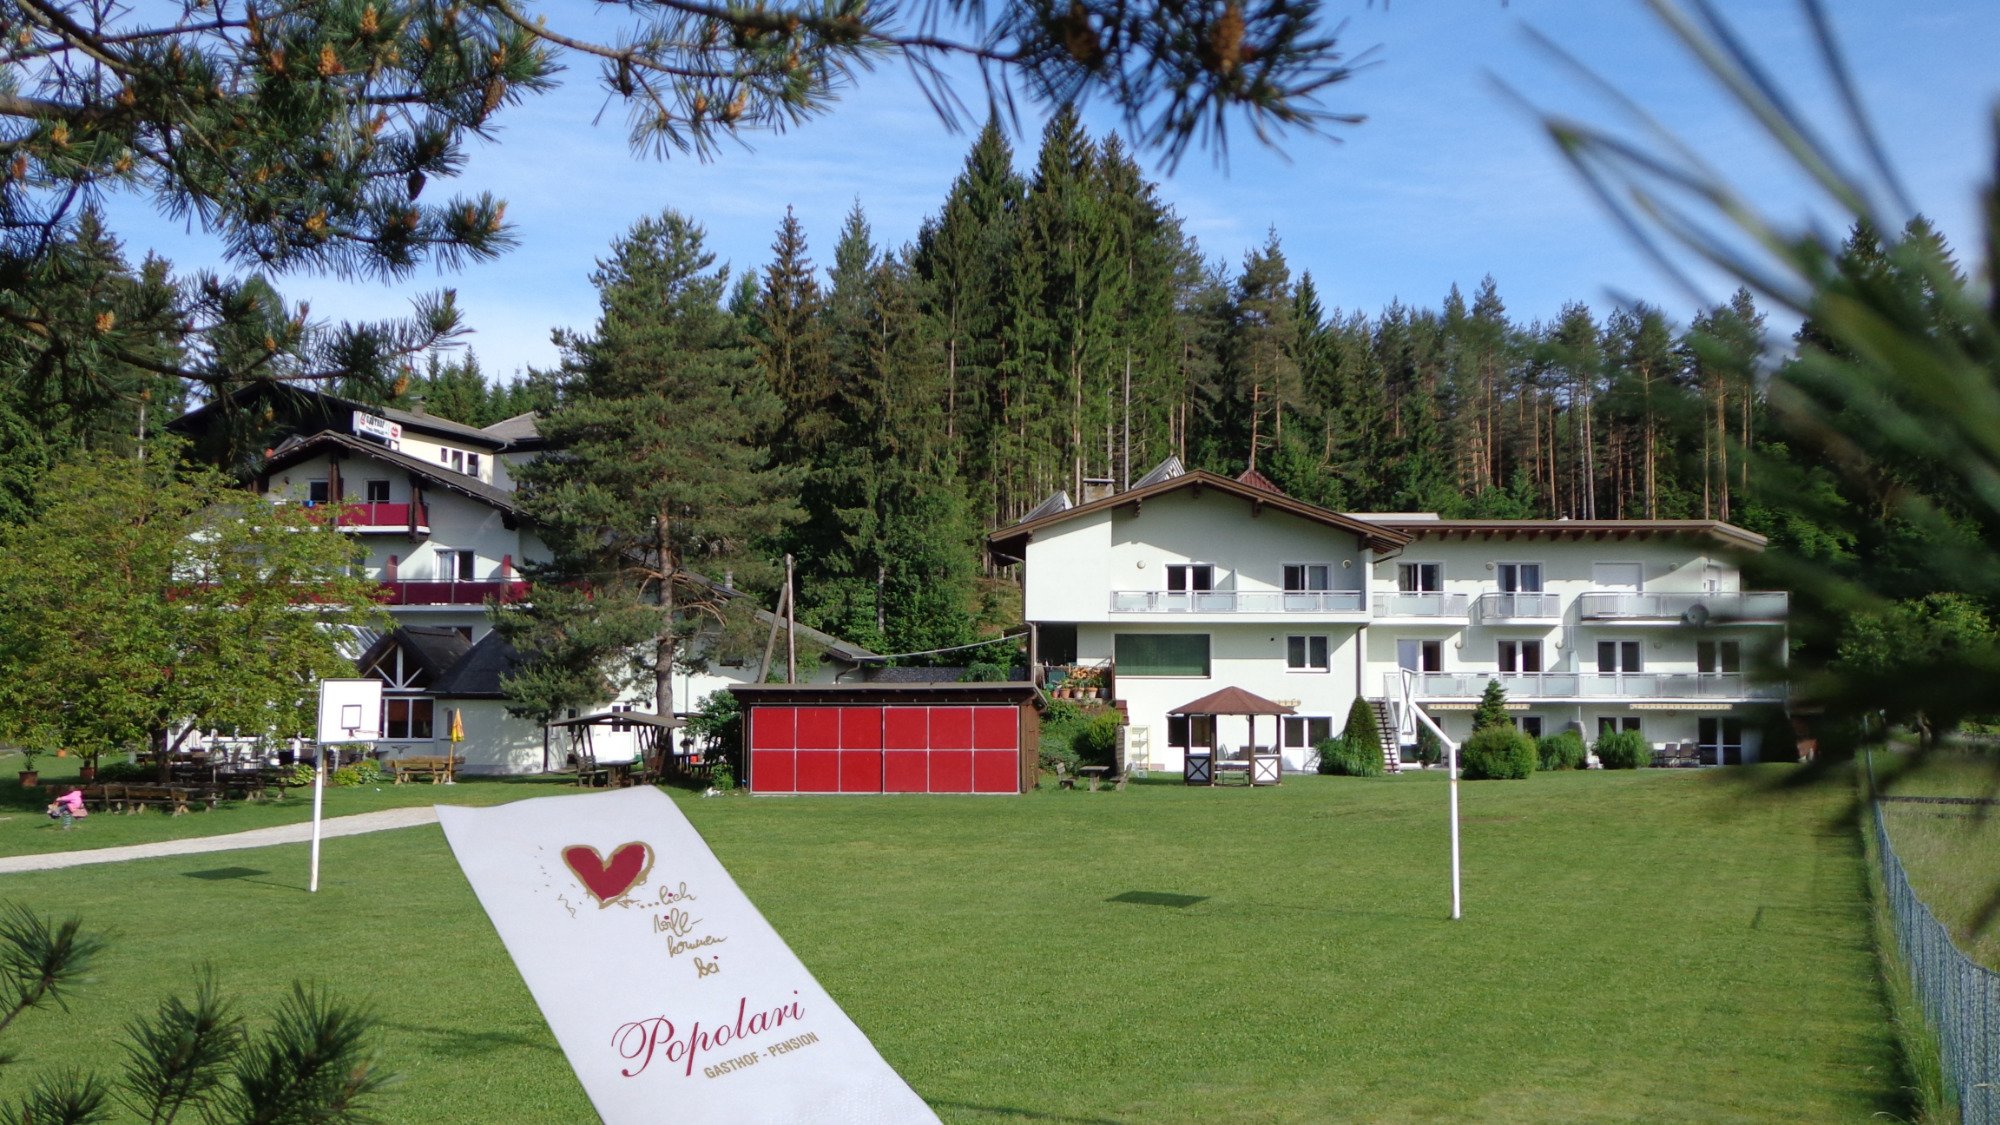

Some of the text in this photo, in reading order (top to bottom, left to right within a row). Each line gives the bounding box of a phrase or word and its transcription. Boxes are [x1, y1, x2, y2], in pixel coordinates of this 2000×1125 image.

[611, 990, 805, 1077] Popolari
[703, 1052, 760, 1079] GASTHOF
[767, 1031, 820, 1058] PENSION
